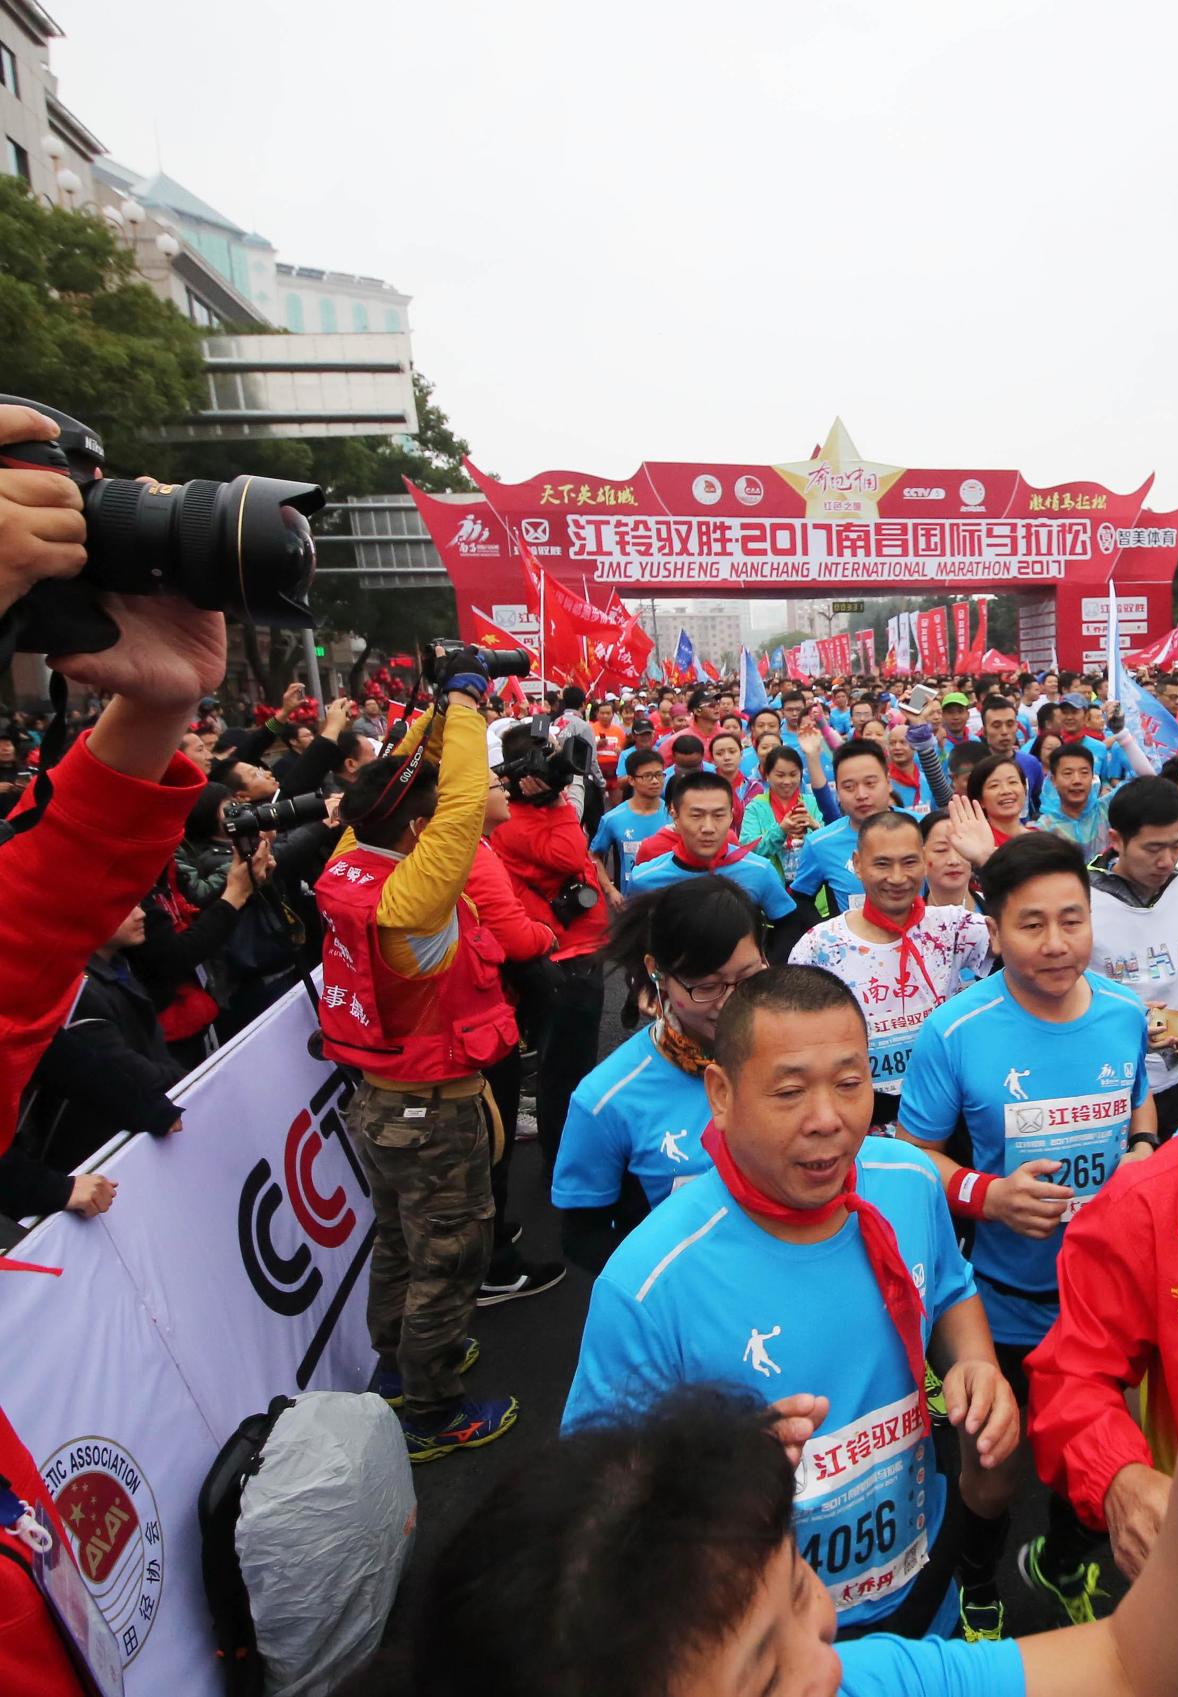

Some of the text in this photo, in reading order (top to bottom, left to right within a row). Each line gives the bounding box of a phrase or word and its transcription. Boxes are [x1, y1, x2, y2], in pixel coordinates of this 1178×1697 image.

[540, 484, 639, 507] 天下英雄城
[1119, 529, 1175, 546] 智美体育
[597, 560, 1064, 579] JMC YUSHENG NANCHANG INTERNATIONAL MARATHON 2017
[399, 745, 424, 783] EOS 70D
[1048, 1097, 1128, 1127] 江铃驭胜
[70, 1445, 142, 1496] ASSOCIATION
